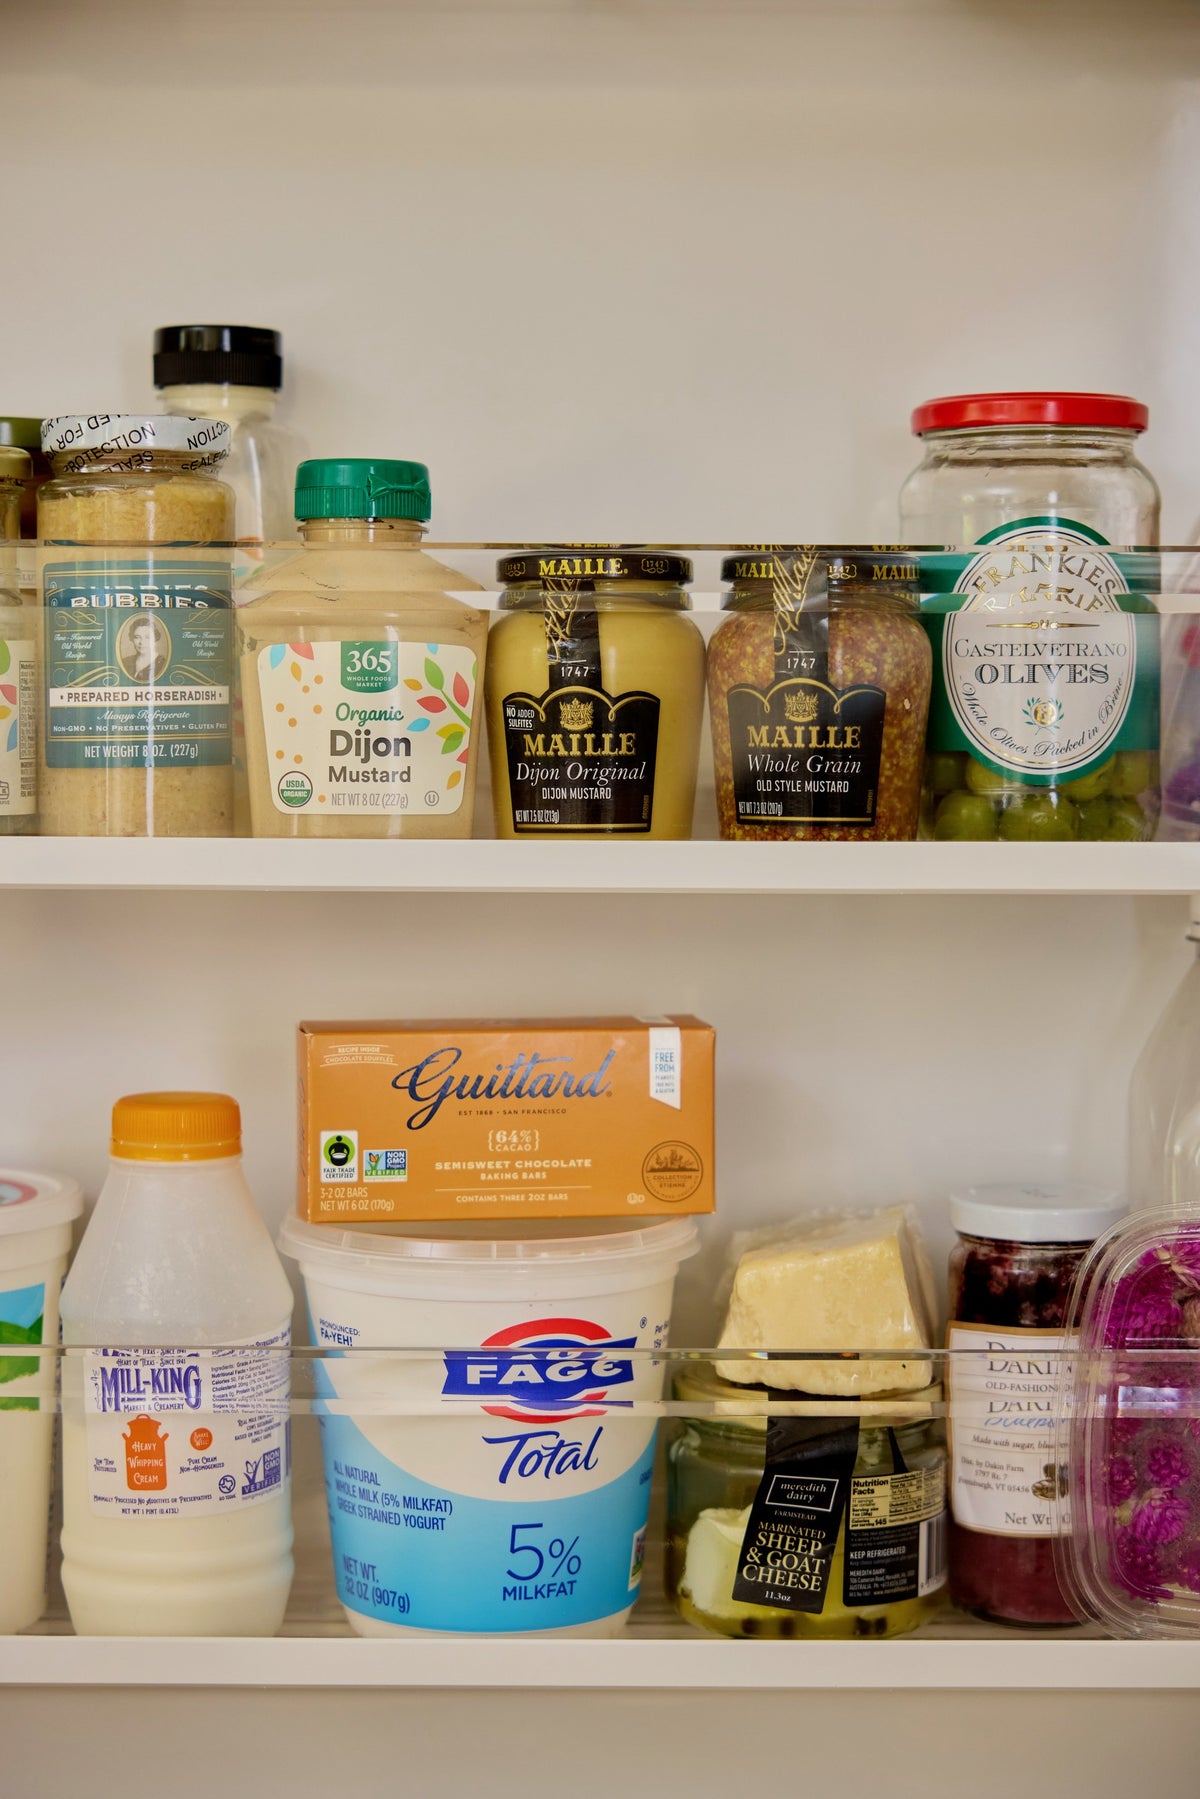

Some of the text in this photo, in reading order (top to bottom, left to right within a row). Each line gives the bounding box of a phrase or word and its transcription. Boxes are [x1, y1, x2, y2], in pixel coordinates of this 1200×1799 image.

[539, 558, 624, 576] MAILLE
[646, 560, 664, 570] 1747
[828, 565, 850, 574] 1747
[971, 552, 1116, 594] FRANKIES
[954, 638, 1128, 658] CASTELVETRANO
[346, 648, 392, 673] 365
[787, 658, 816, 669] 1747
[561, 666, 590, 678] 1747
[974, 663, 1109, 685] OLIVES
[67, 690, 217, 702] PREPARED HORSERADISH
[97, 710, 190, 722] Always Refrigerate
[335, 702, 404, 727] Organic
[506, 707, 535, 718] NO ADDED
[960, 678, 1124, 758] Whole Olives Packed in Brine
[53, 724, 86, 732] NON-GMO
[508, 719, 533, 728] SULFITES
[747, 725, 861, 749] MAILLE
[329, 728, 412, 764] Dijon
[523, 732, 636, 757] MAILLE
[84, 743, 199, 760] NET WEIGHT 8 OZ. (227g)
[748, 754, 861, 774] Whole Grain
[328, 766, 412, 783] Mustard
[516, 762, 647, 786] Dijon Original
[285, 780, 305, 788] USDA
[756, 779, 849, 793] OLD STYLE MUSTARD
[283, 790, 308, 798] ORGANIC
[542, 787, 612, 799] DIJON MUSTARD
[331, 792, 409, 809] NET WT 8 OZ (227g)
[325, 1056, 362, 1064] CHOCOLATE
[655, 1052, 674, 1063] FREE
[655, 1063, 675, 1073] FROM
[391, 1047, 616, 1131] Guittard
[496, 1144, 531, 1152] CACAO
[435, 1159, 592, 1171] SEMISWEET CHOCOLATE
[522, 1172, 547, 1180] BARS
[320, 1187, 368, 1199] 3-2 OZ BARS
[456, 1195, 497, 1203] CONTAINS
[500, 1194, 525, 1202] THREE
[548, 1193, 568, 1201] BARS
[320, 1200, 394, 1212] NET WT 6 OZ (170g)
[319, 1318, 361, 1337] PRONOUNCED:
[320, 1328, 353, 1346] FA-YEH!
[116, 1358, 132, 1367] HEART
[139, 1358, 155, 1366] TEXAS
[160, 1358, 175, 1366] SINCE
[100, 1365, 202, 1413] MILL-KING
[124, 1402, 185, 1412] MARKET CREAMERY
[132, 1442, 156, 1452] HEAVY
[972, 1434, 991, 1445] Made
[993, 1438, 1010, 1447] with
[1012, 1438, 1036, 1451] sugar,
[201, 1456, 218, 1464] CREAM
[264, 1451, 280, 1462] NON
[482, 1426, 603, 1484] Total
[127, 1457, 163, 1468] WHIPPING
[265, 1459, 280, 1469] GMO
[1006, 1461, 1024, 1473] Farm
[133, 1472, 158, 1485] CREAM
[334, 1460, 381, 1486] ALL NATURAL
[243, 1476, 281, 1494] VERIFIED
[780, 1482, 828, 1493] meredith
[852, 1479, 889, 1488] Nutrition
[995, 1483, 1005, 1491] VT
[335, 1480, 453, 1515] WHOLE MILK (5% MILKFAT)
[786, 1491, 815, 1503] dairy
[337, 1497, 446, 1531] GREEK STRAINED YOGURT
[774, 1509, 816, 1521] FARMSTEAD
[1004, 1512, 1027, 1526] Net
[758, 1522, 826, 1540] MARINATED
[756, 1531, 822, 1557] SHEEP
[506, 1522, 582, 1581] 5%
[850, 1551, 865, 1560] KEEP
[866, 1546, 906, 1559] REFRIGERATED
[746, 1546, 763, 1565] &
[766, 1550, 826, 1576] GOAT
[343, 1556, 379, 1584] NET WT.
[742, 1564, 823, 1592] CHEESE
[345, 1577, 411, 1614] 32 OZ (907g)
[502, 1580, 577, 1601] MILKFAT
[764, 1589, 792, 1602] 11.3oz
